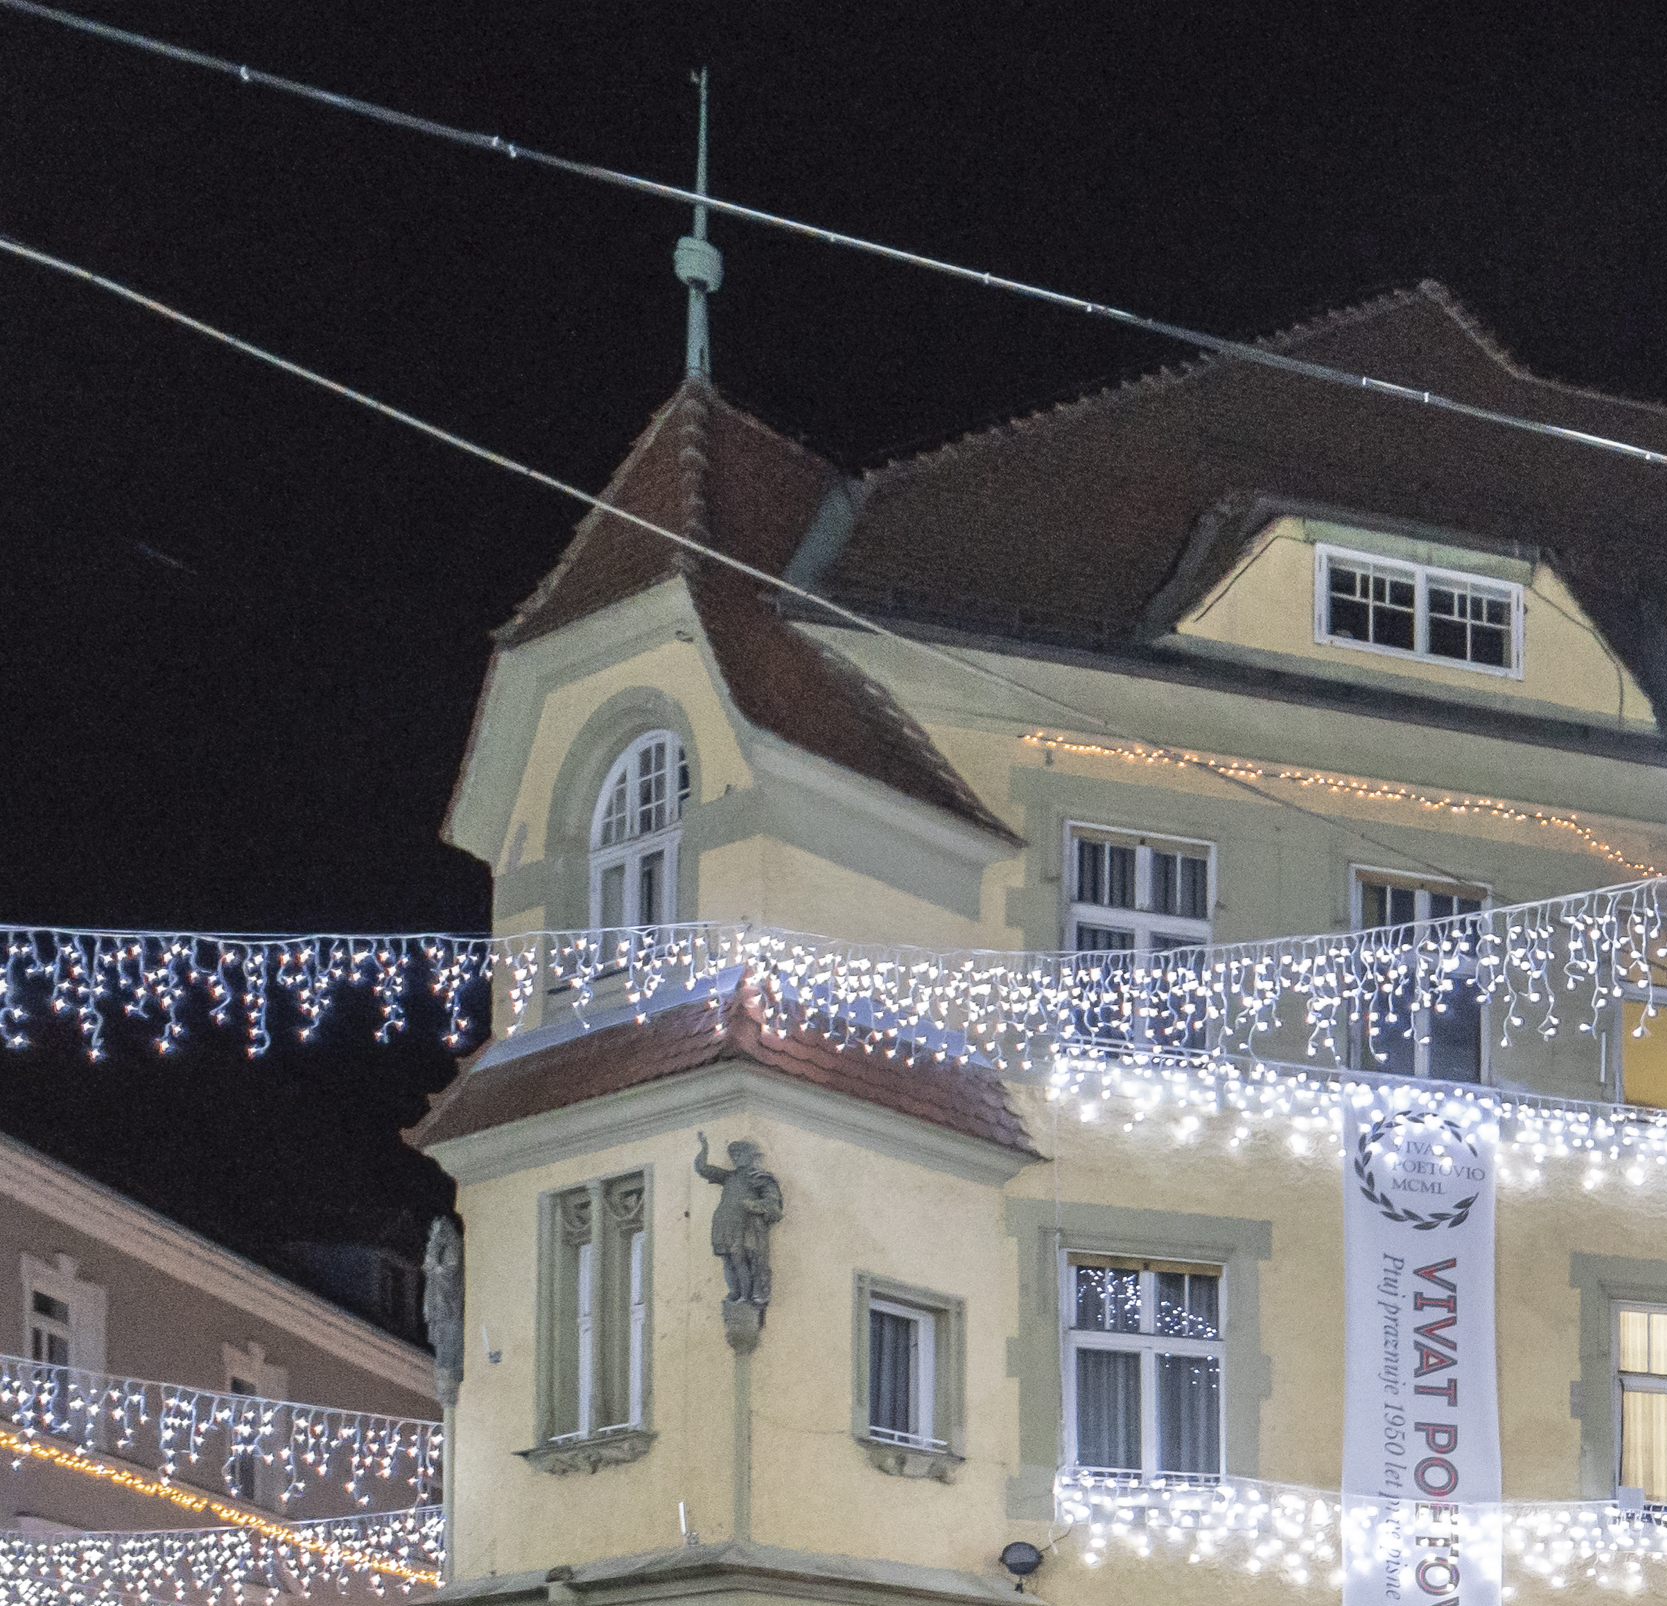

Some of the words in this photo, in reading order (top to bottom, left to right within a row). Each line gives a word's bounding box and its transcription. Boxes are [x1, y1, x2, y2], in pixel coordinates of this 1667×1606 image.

[1391, 1178, 1447, 1195] MCML
[1377, 1253, 1406, 1299] Ptuj
[1377, 1300, 1406, 1396] praznuje
[1413, 1257, 1458, 1407] VIVAT
[1384, 1402, 1407, 1456] 1950
[1385, 1461, 1408, 1488] let
